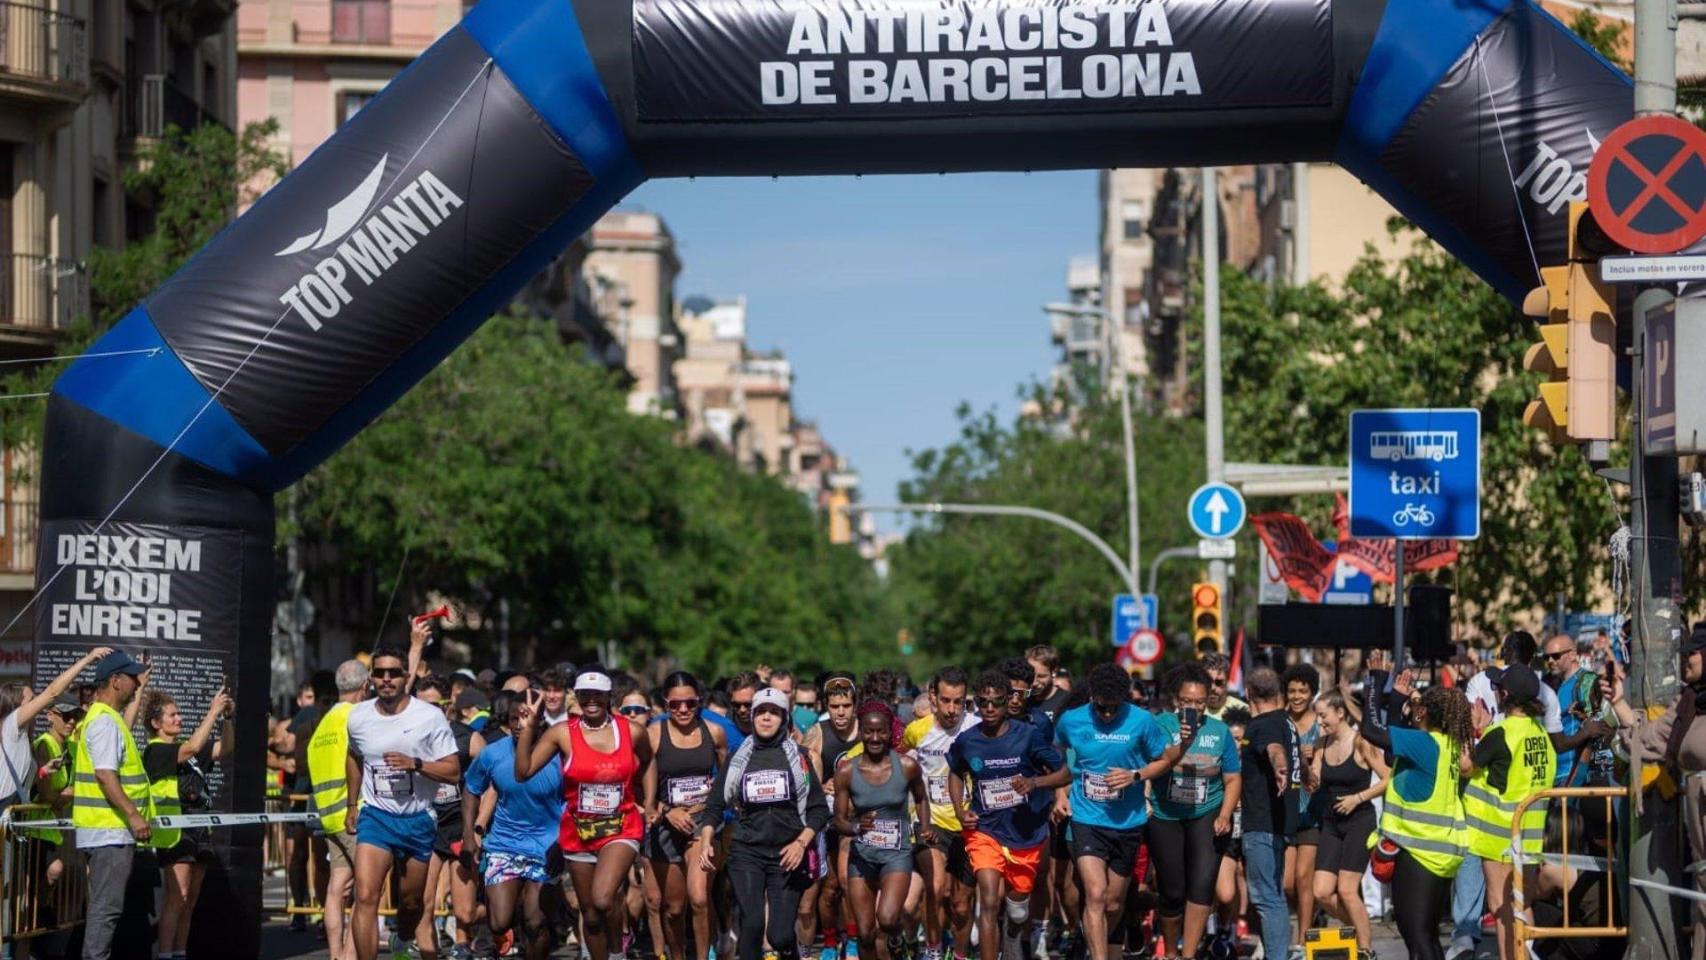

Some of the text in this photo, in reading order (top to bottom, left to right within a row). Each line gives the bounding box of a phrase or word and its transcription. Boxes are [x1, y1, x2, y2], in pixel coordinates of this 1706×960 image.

[787, 2, 1174, 55] ANTIRACISTA
[760, 52, 1202, 104] DE BARCELONA
[1514, 140, 1588, 216] TOP
[279, 169, 465, 332] TOP MANTA
[1666, 264, 1676, 272] en
[1389, 471, 1441, 495] taxi
[57, 534, 202, 571] DEIXEM
[75, 568, 171, 605] L'ODI
[51, 603, 202, 641] ENRERE
